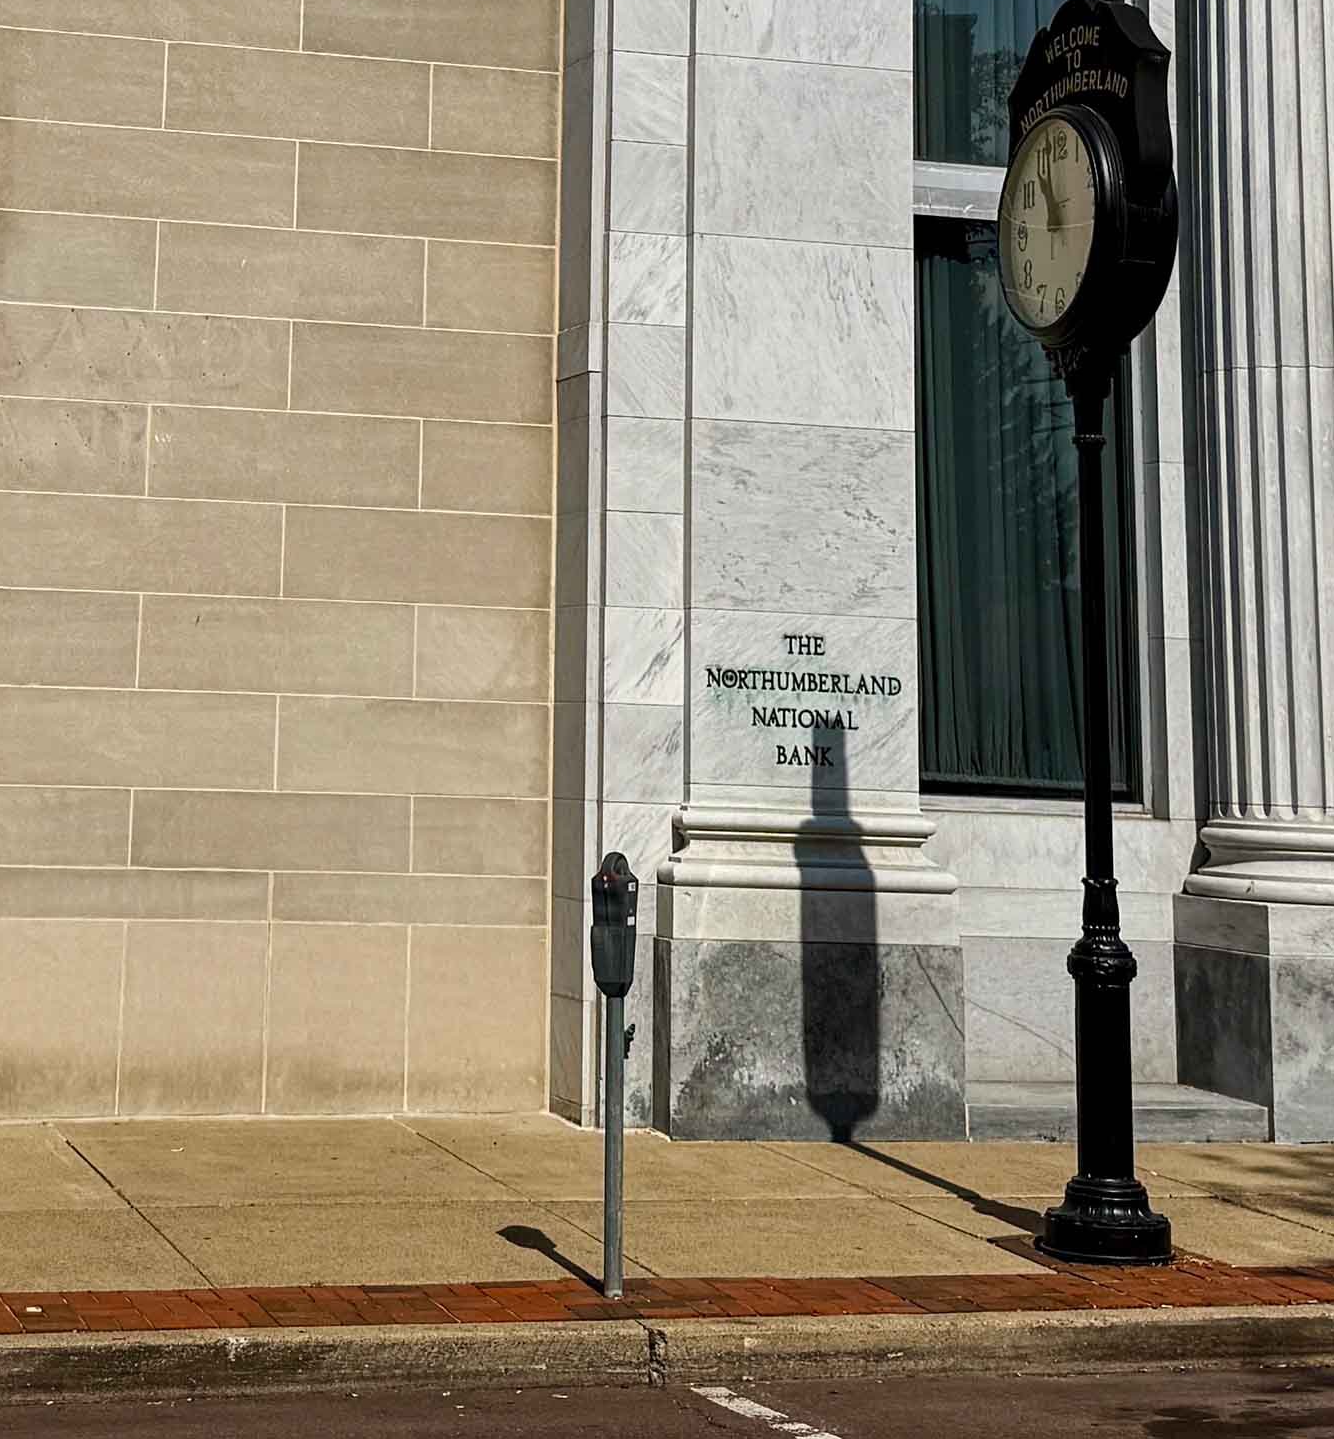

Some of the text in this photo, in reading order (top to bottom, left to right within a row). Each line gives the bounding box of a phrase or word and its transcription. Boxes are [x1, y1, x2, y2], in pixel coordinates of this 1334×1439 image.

[1045, 24, 1100, 64] WELCOME
[1066, 49, 1082, 73] TO
[1020, 69, 1128, 136] NORTHUMBERLAND
[1053, 131, 1067, 163] 12
[1023, 180, 1035, 210] 10
[1018, 221, 1028, 252] 9
[1024, 259, 1033, 290] 8
[1037, 284, 1048, 313] 7
[783, 634, 826, 656] THE
[705, 668, 902, 696] NORTHUMBERLAND
[751, 707, 859, 730] NATIONAL
[776, 745, 834, 767] BANK
